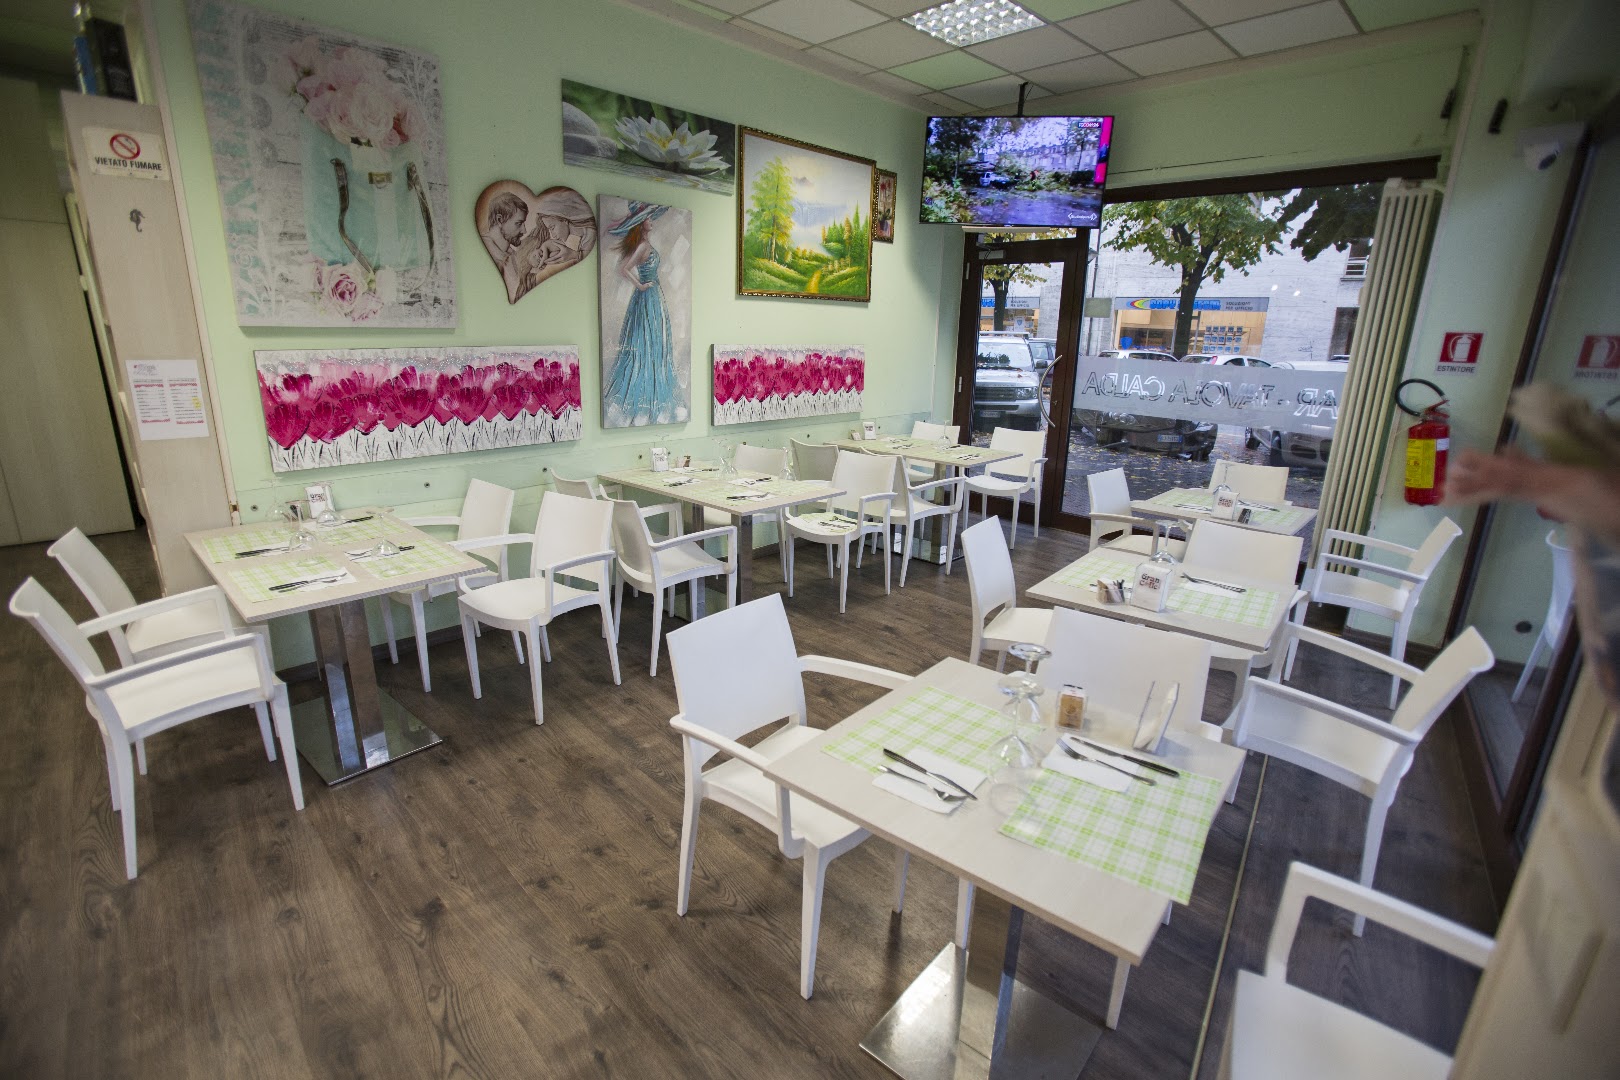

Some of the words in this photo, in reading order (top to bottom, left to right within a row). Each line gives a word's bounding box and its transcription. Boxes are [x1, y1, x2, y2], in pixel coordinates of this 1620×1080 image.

[95, 157, 128, 168] VIETATO
[130, 160, 162, 171] FUMARE
[1149, 299, 1176, 309] COPY
[1437, 365, 1476, 374] ESTINTORE
